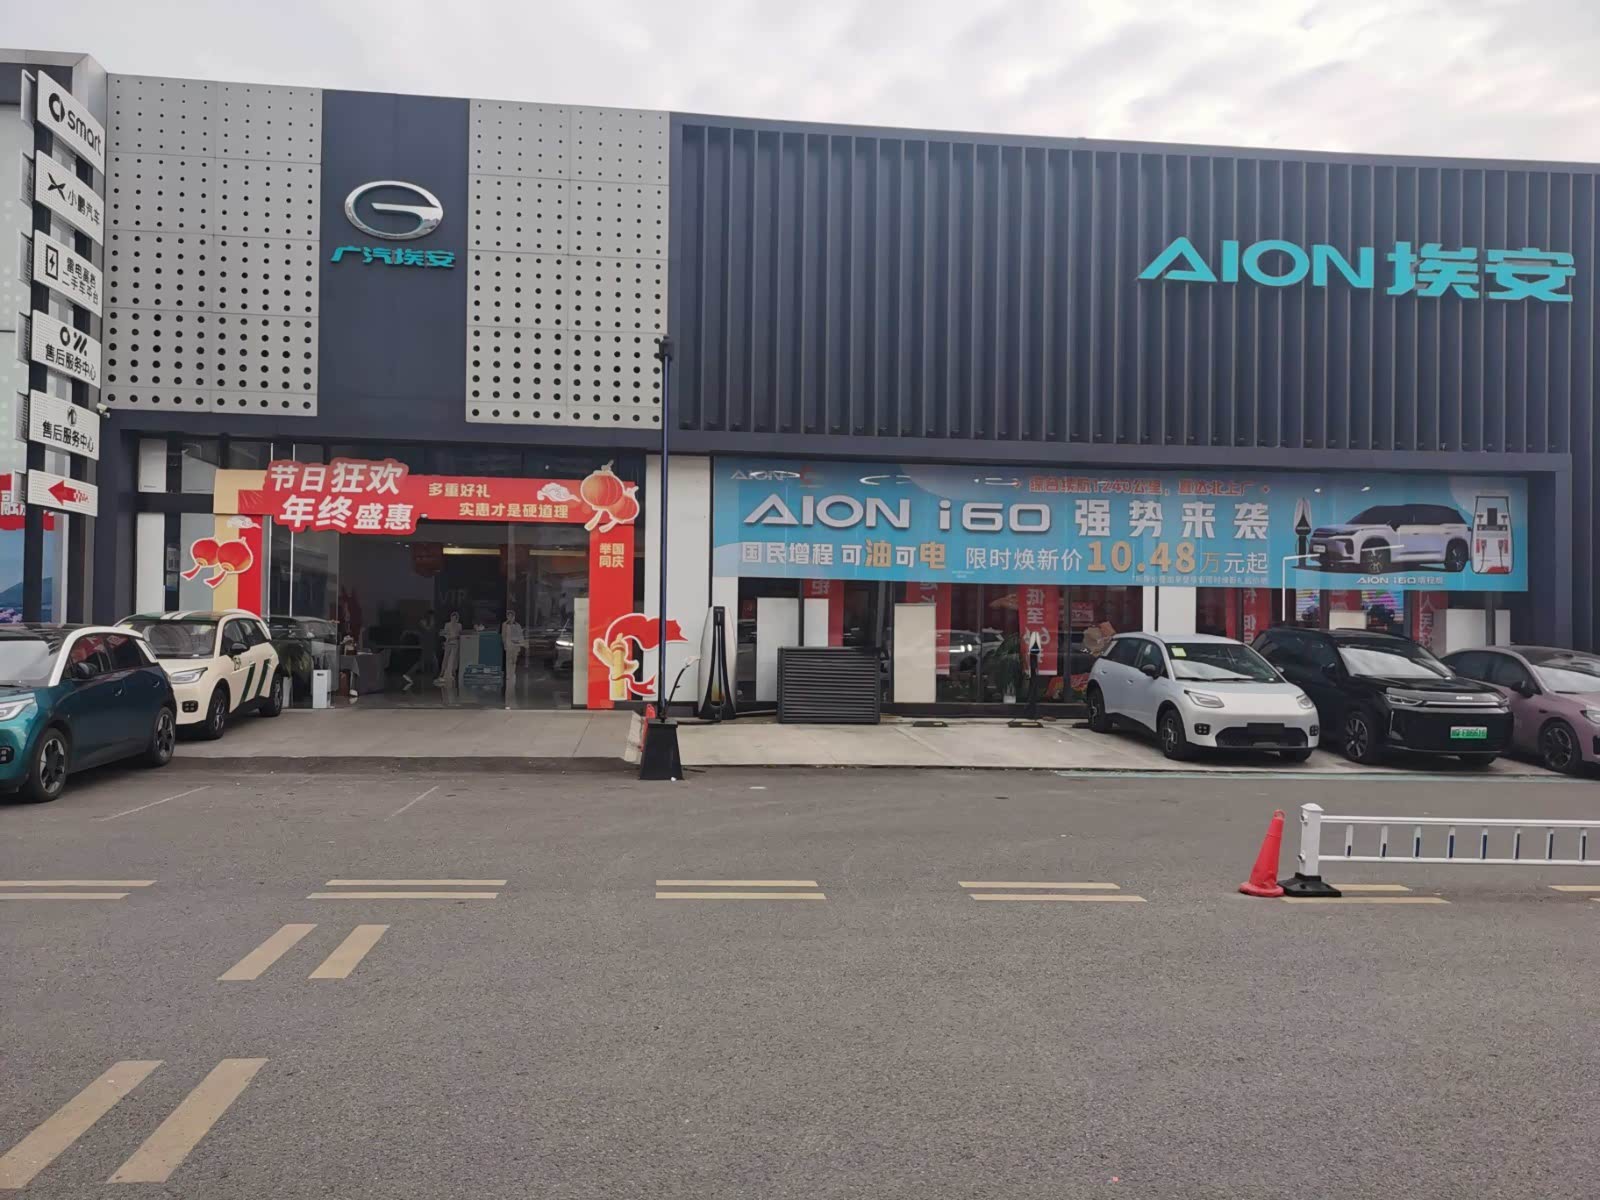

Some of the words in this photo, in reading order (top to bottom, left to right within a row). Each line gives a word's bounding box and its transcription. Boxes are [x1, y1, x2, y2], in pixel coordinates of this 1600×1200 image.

[67, 111, 102, 156] smart
[330, 245, 456, 269] 广汽埃安
[1137, 236, 1374, 290] AION
[1387, 241, 1577, 303] 埃安
[45, 343, 97, 382] 售后服务中心
[42, 420, 95, 453] 售后服务中心
[271, 462, 403, 495] 节日狂欢
[428, 482, 490, 498] 多重好礼
[279, 494, 414, 531] 年终盛惠
[459, 502, 569, 518] 实惠才是硬道理
[743, 493, 911, 530] AION
[938, 500, 1051, 533] i60
[1074, 499, 1269, 540] 强势来袭
[599, 542, 625, 555] 举国
[599, 555, 625, 568] 同庆
[741, 541, 834, 565] 国民增程
[840, 538, 947, 571] 可油可电
[1356, 577, 1389, 585] AION
